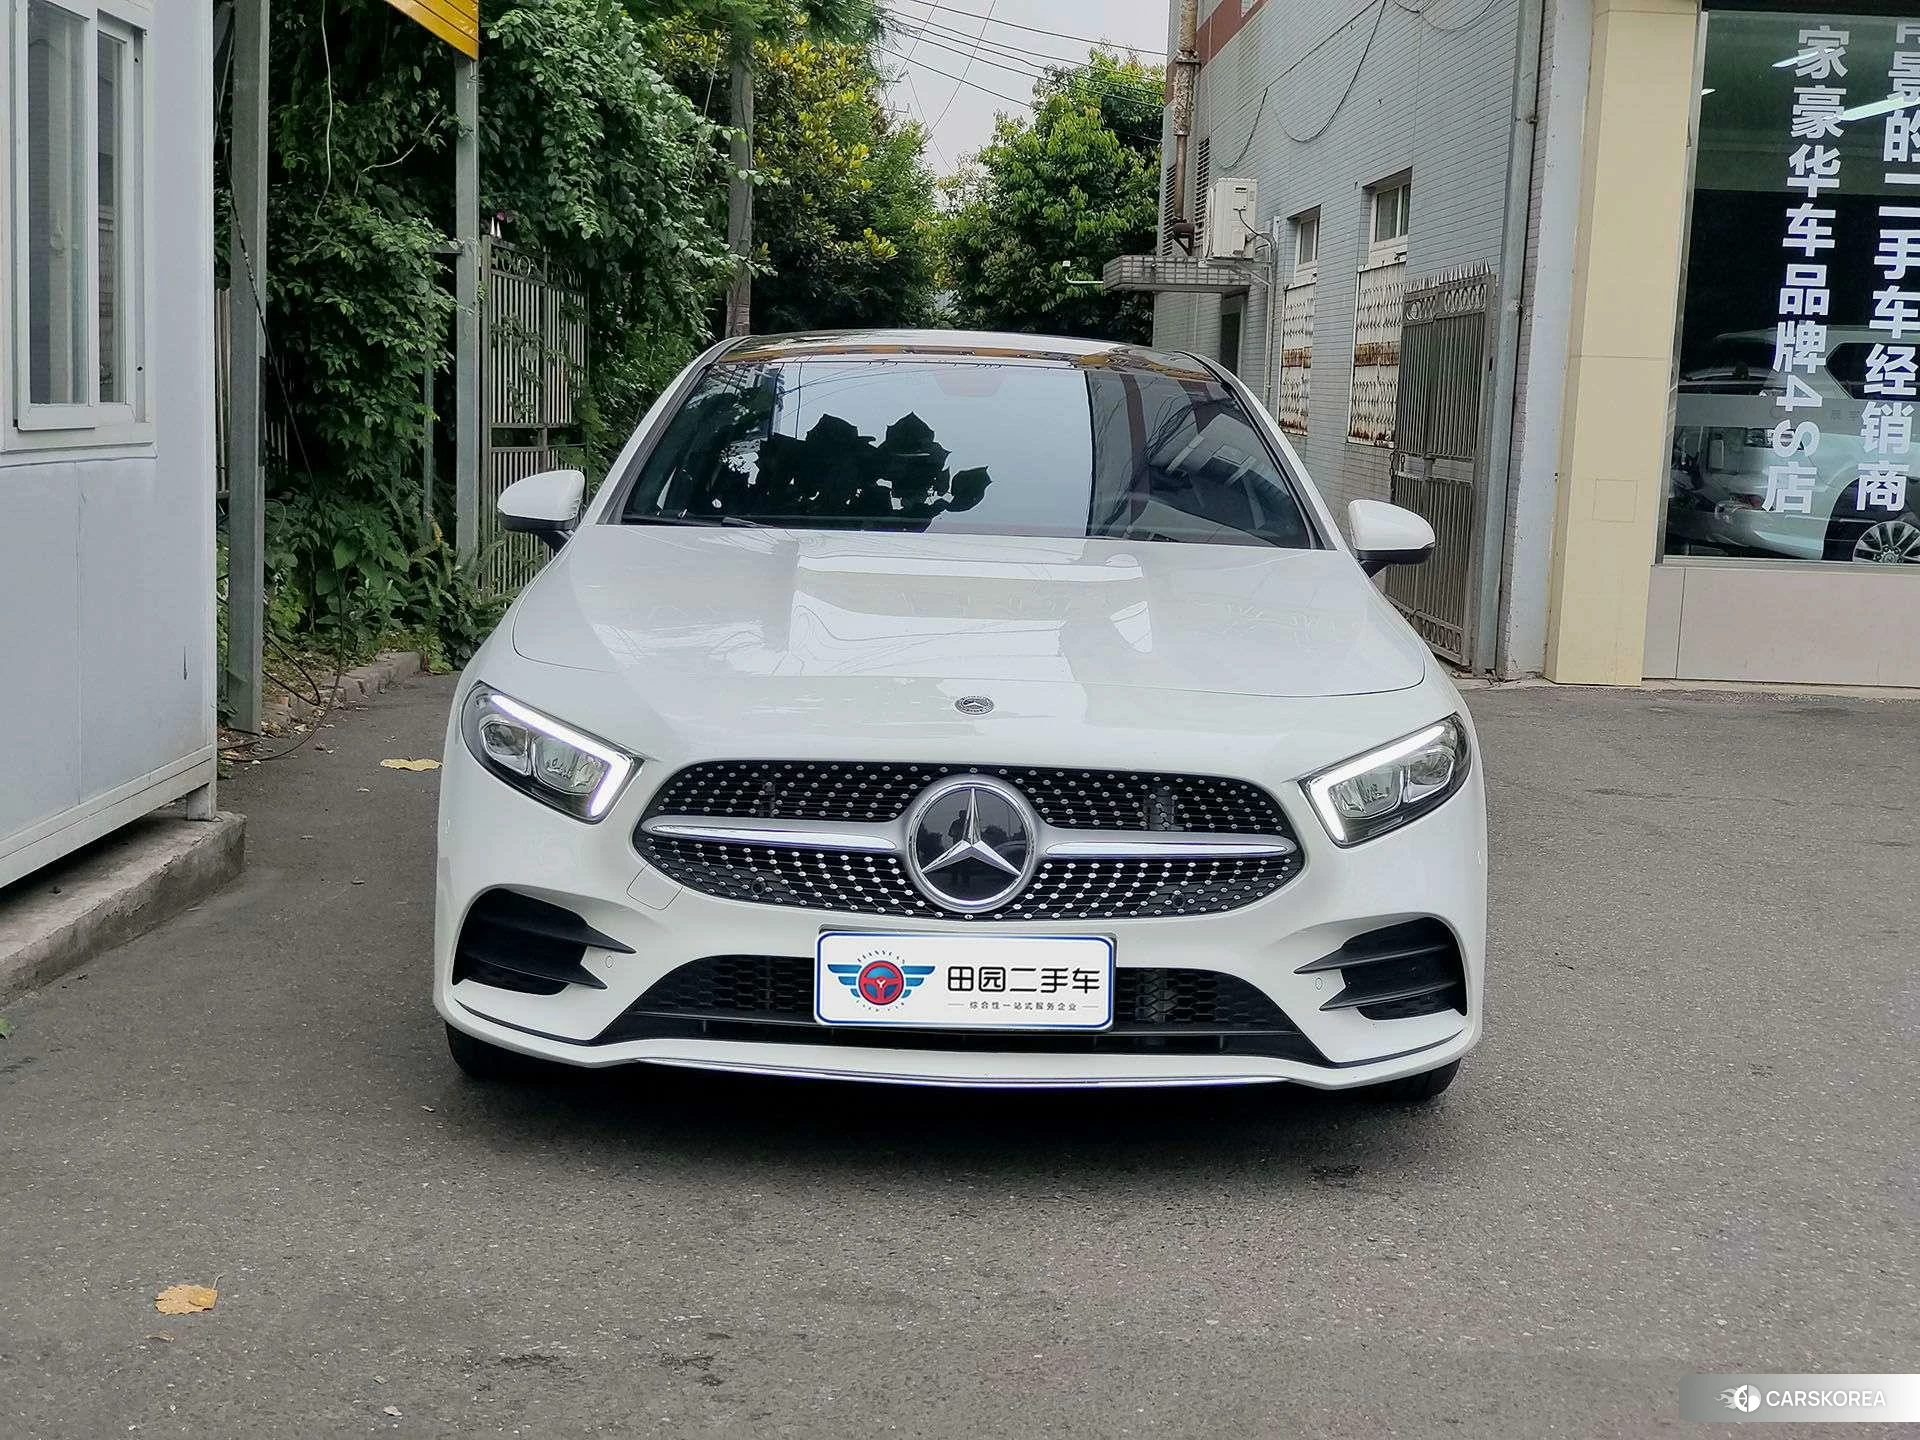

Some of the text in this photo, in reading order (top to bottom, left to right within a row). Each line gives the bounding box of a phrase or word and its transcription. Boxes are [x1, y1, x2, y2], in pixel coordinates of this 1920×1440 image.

[1762, 25, 1849, 514] 家豪华车品牌4S店
[947, 966, 1101, 994] 田园二手车
